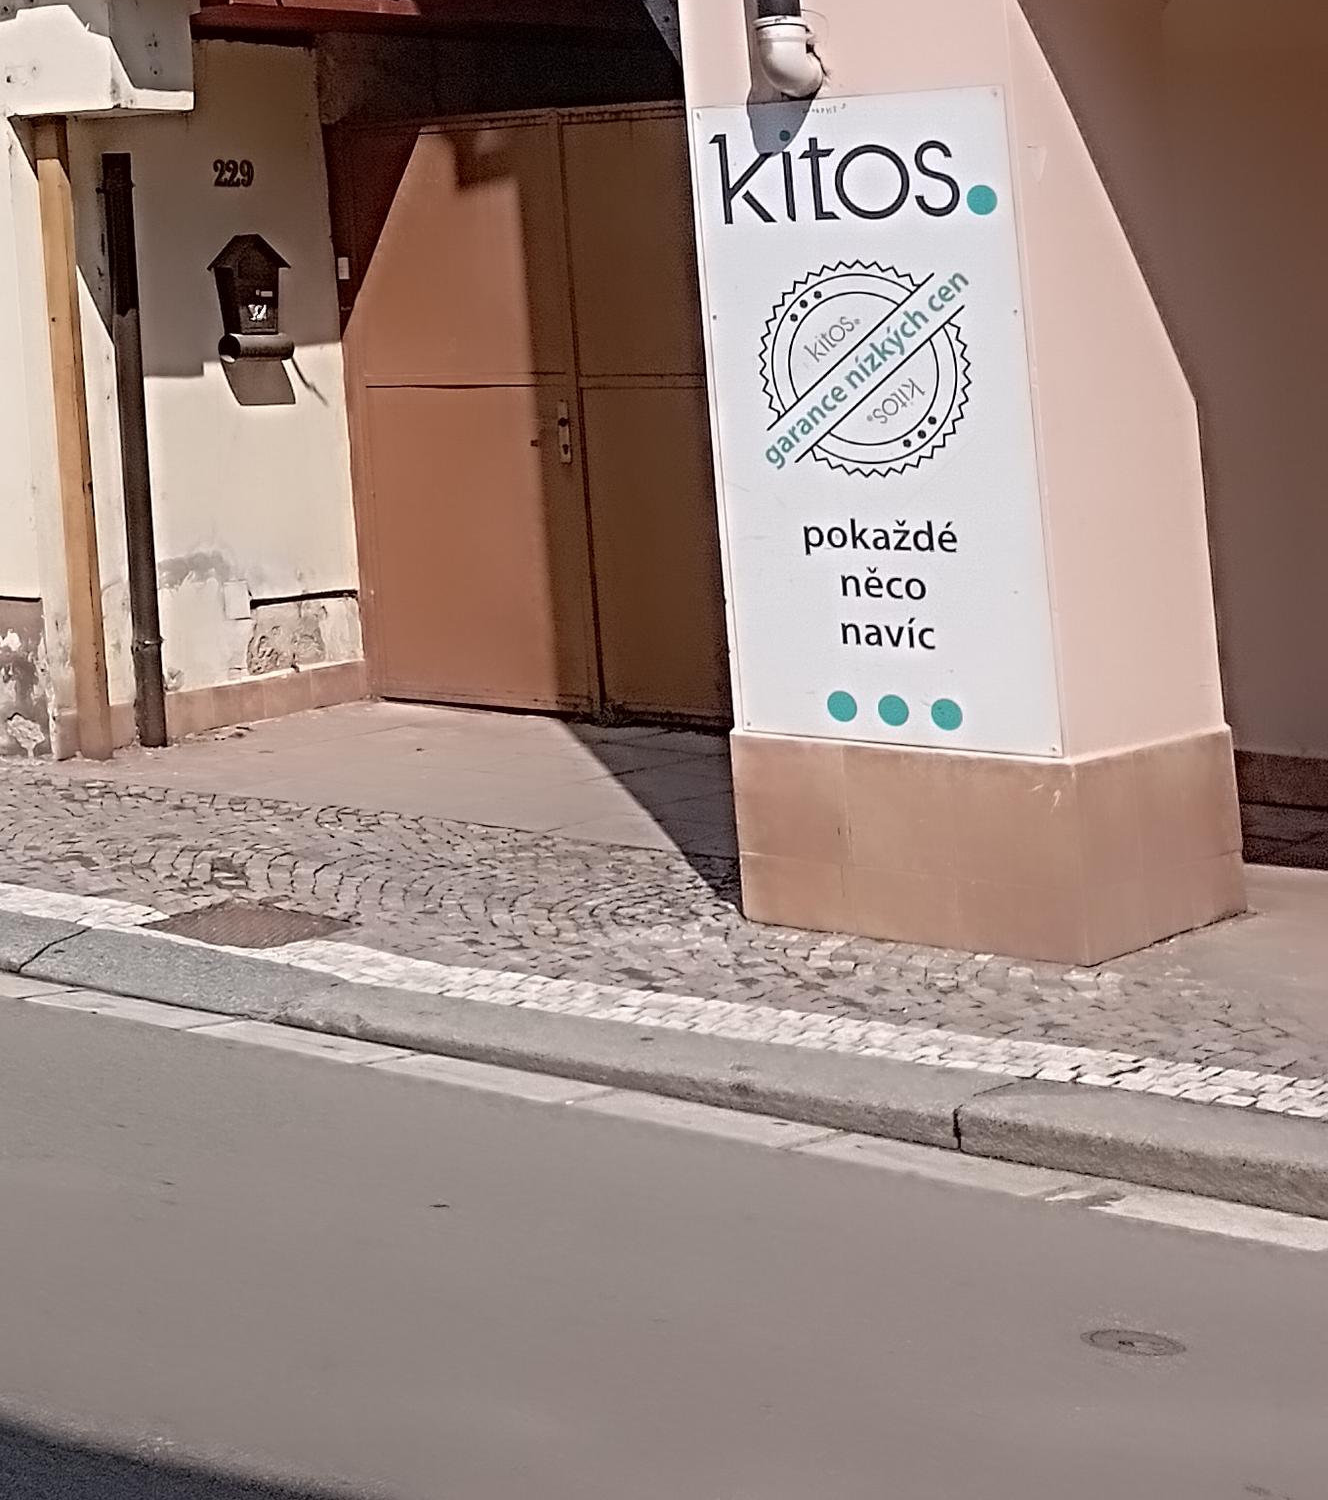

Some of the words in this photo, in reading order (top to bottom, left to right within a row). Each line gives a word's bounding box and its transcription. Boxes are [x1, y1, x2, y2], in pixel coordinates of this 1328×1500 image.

[212, 158, 255, 188] 229
[765, 385, 848, 470] garance
[844, 310, 929, 389] nízkých
[928, 271, 969, 312] cen
[803, 518, 958, 556] pokaždé
[840, 566, 927, 600] něco
[840, 617, 936, 650] navíc
